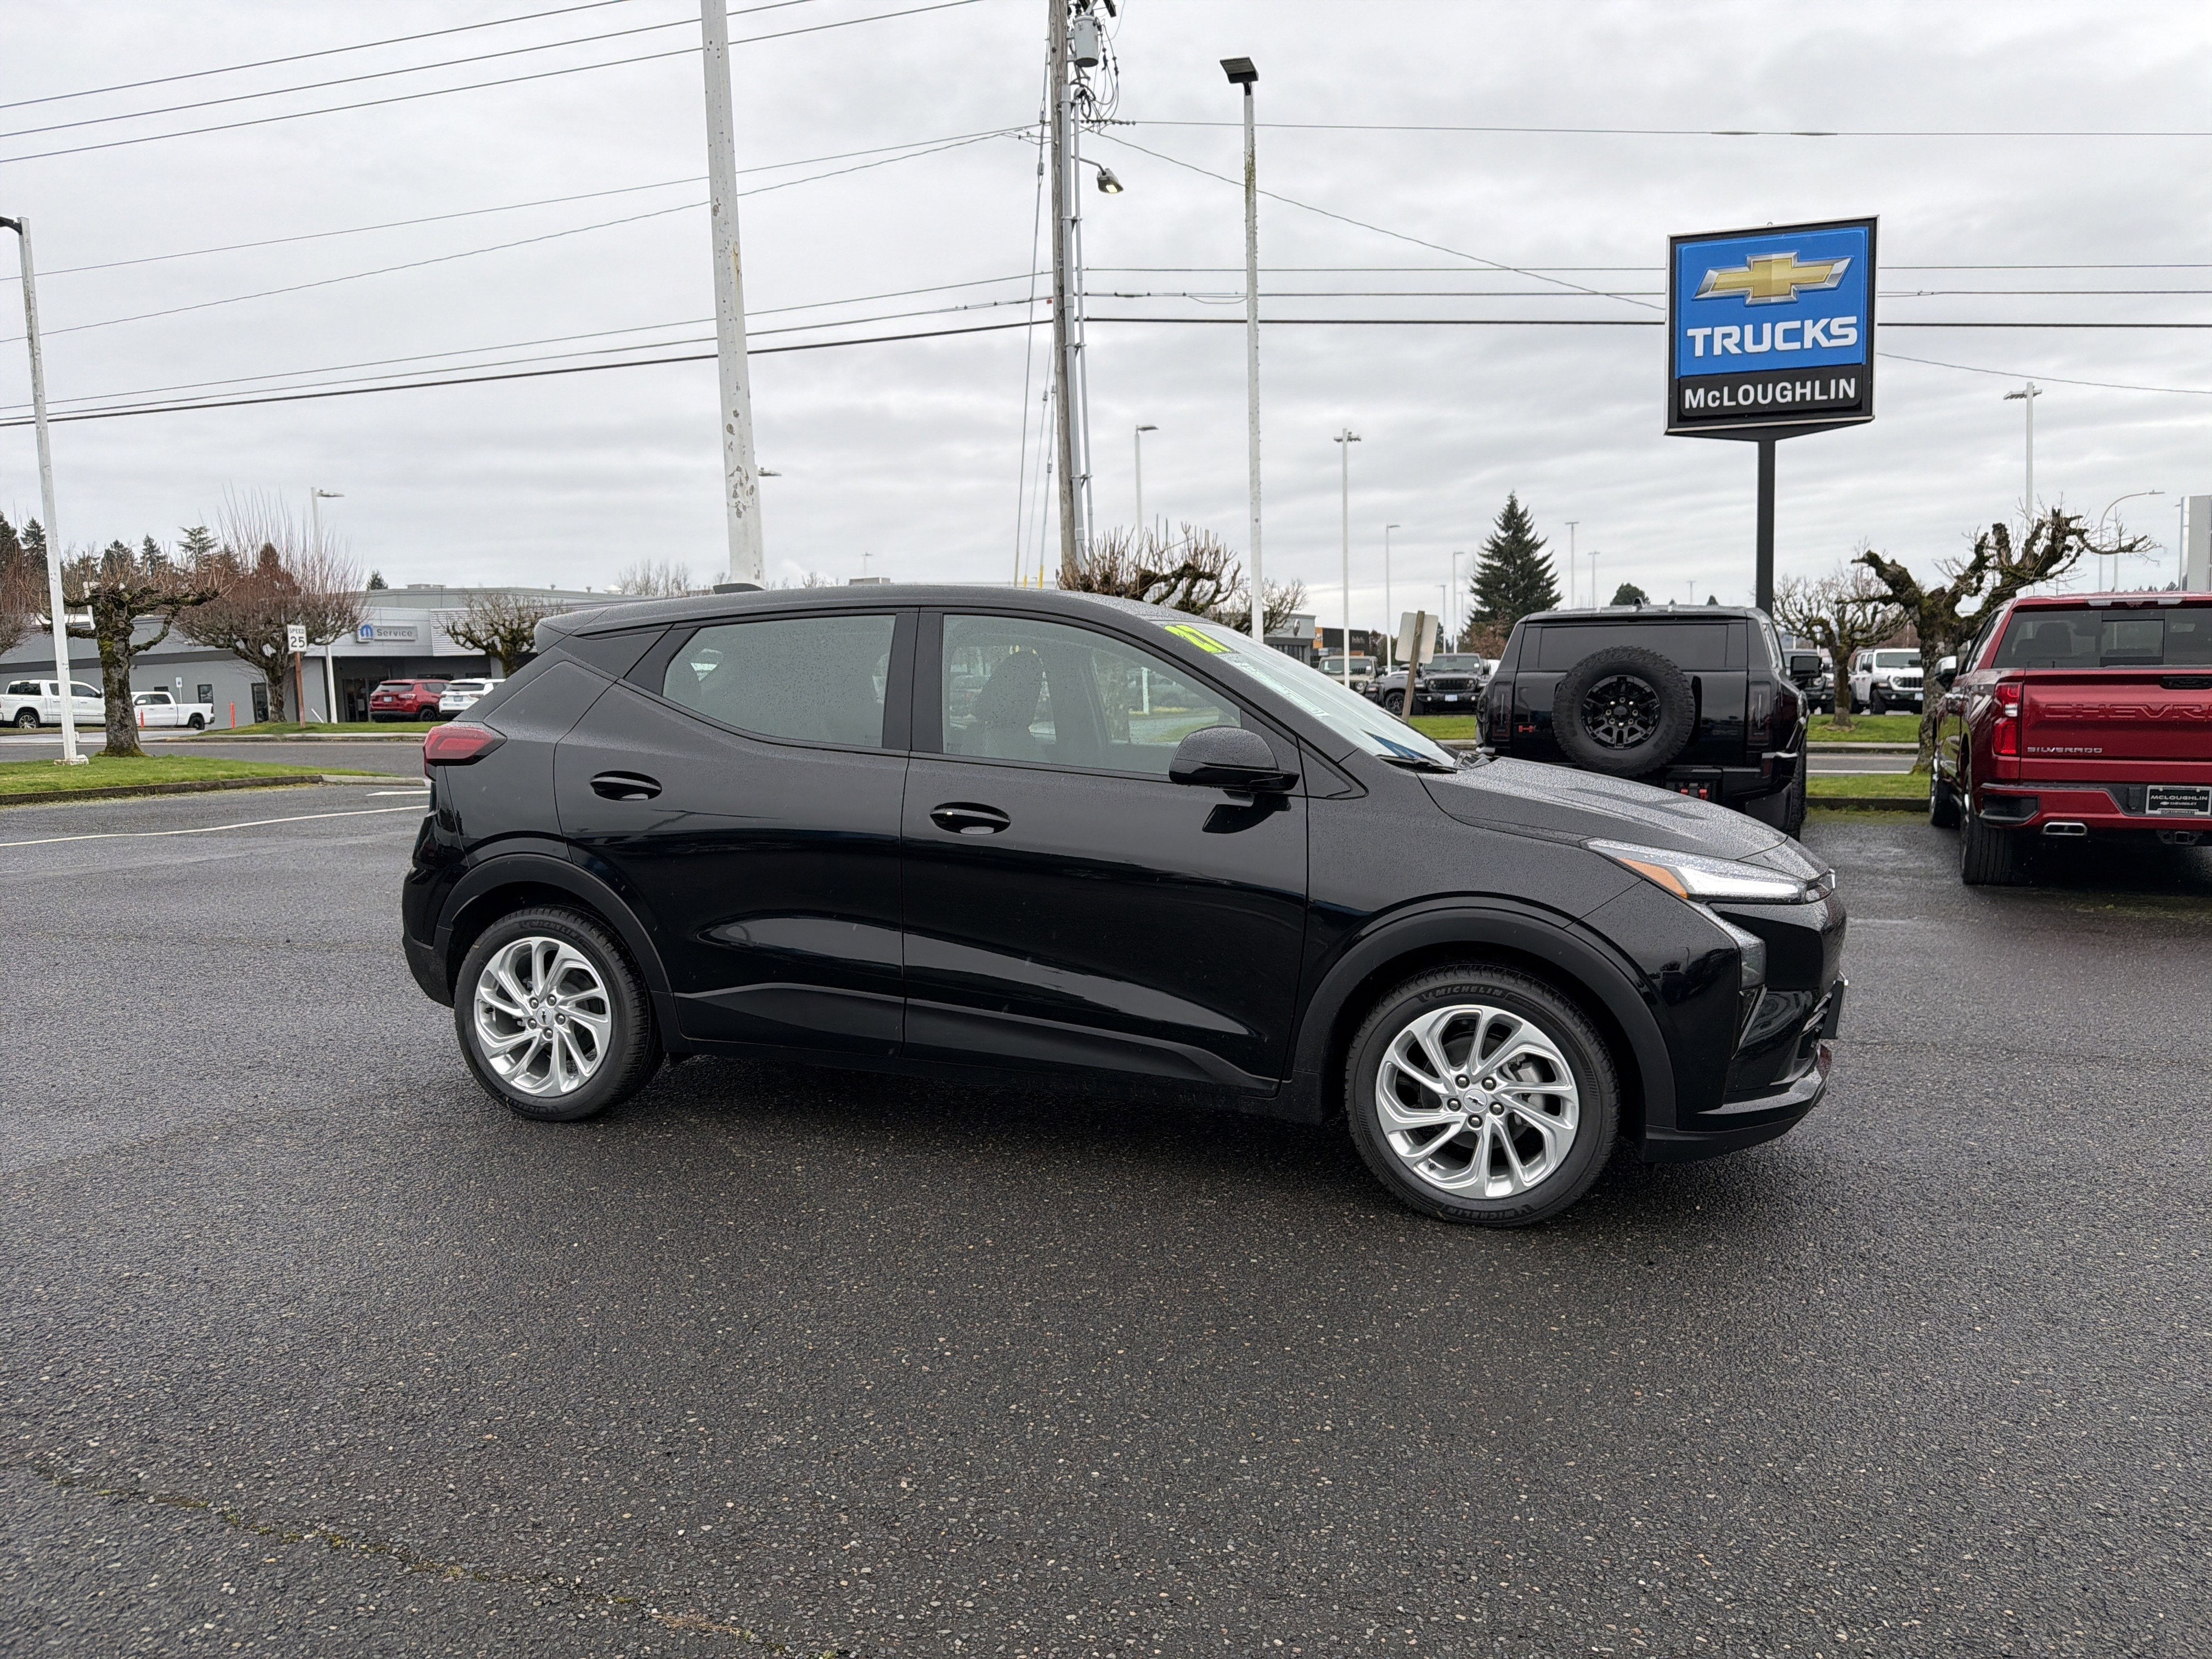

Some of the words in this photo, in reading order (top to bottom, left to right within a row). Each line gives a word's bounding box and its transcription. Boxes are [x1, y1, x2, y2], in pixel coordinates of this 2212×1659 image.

[1687, 316, 1857, 357] TRUCKS
[1685, 377, 1855, 409] McLOUGHLIN
[290, 636, 305, 648] 25
[2045, 704, 2212, 719] CHEVR
[1435, 986, 1503, 997] MICHELIN
